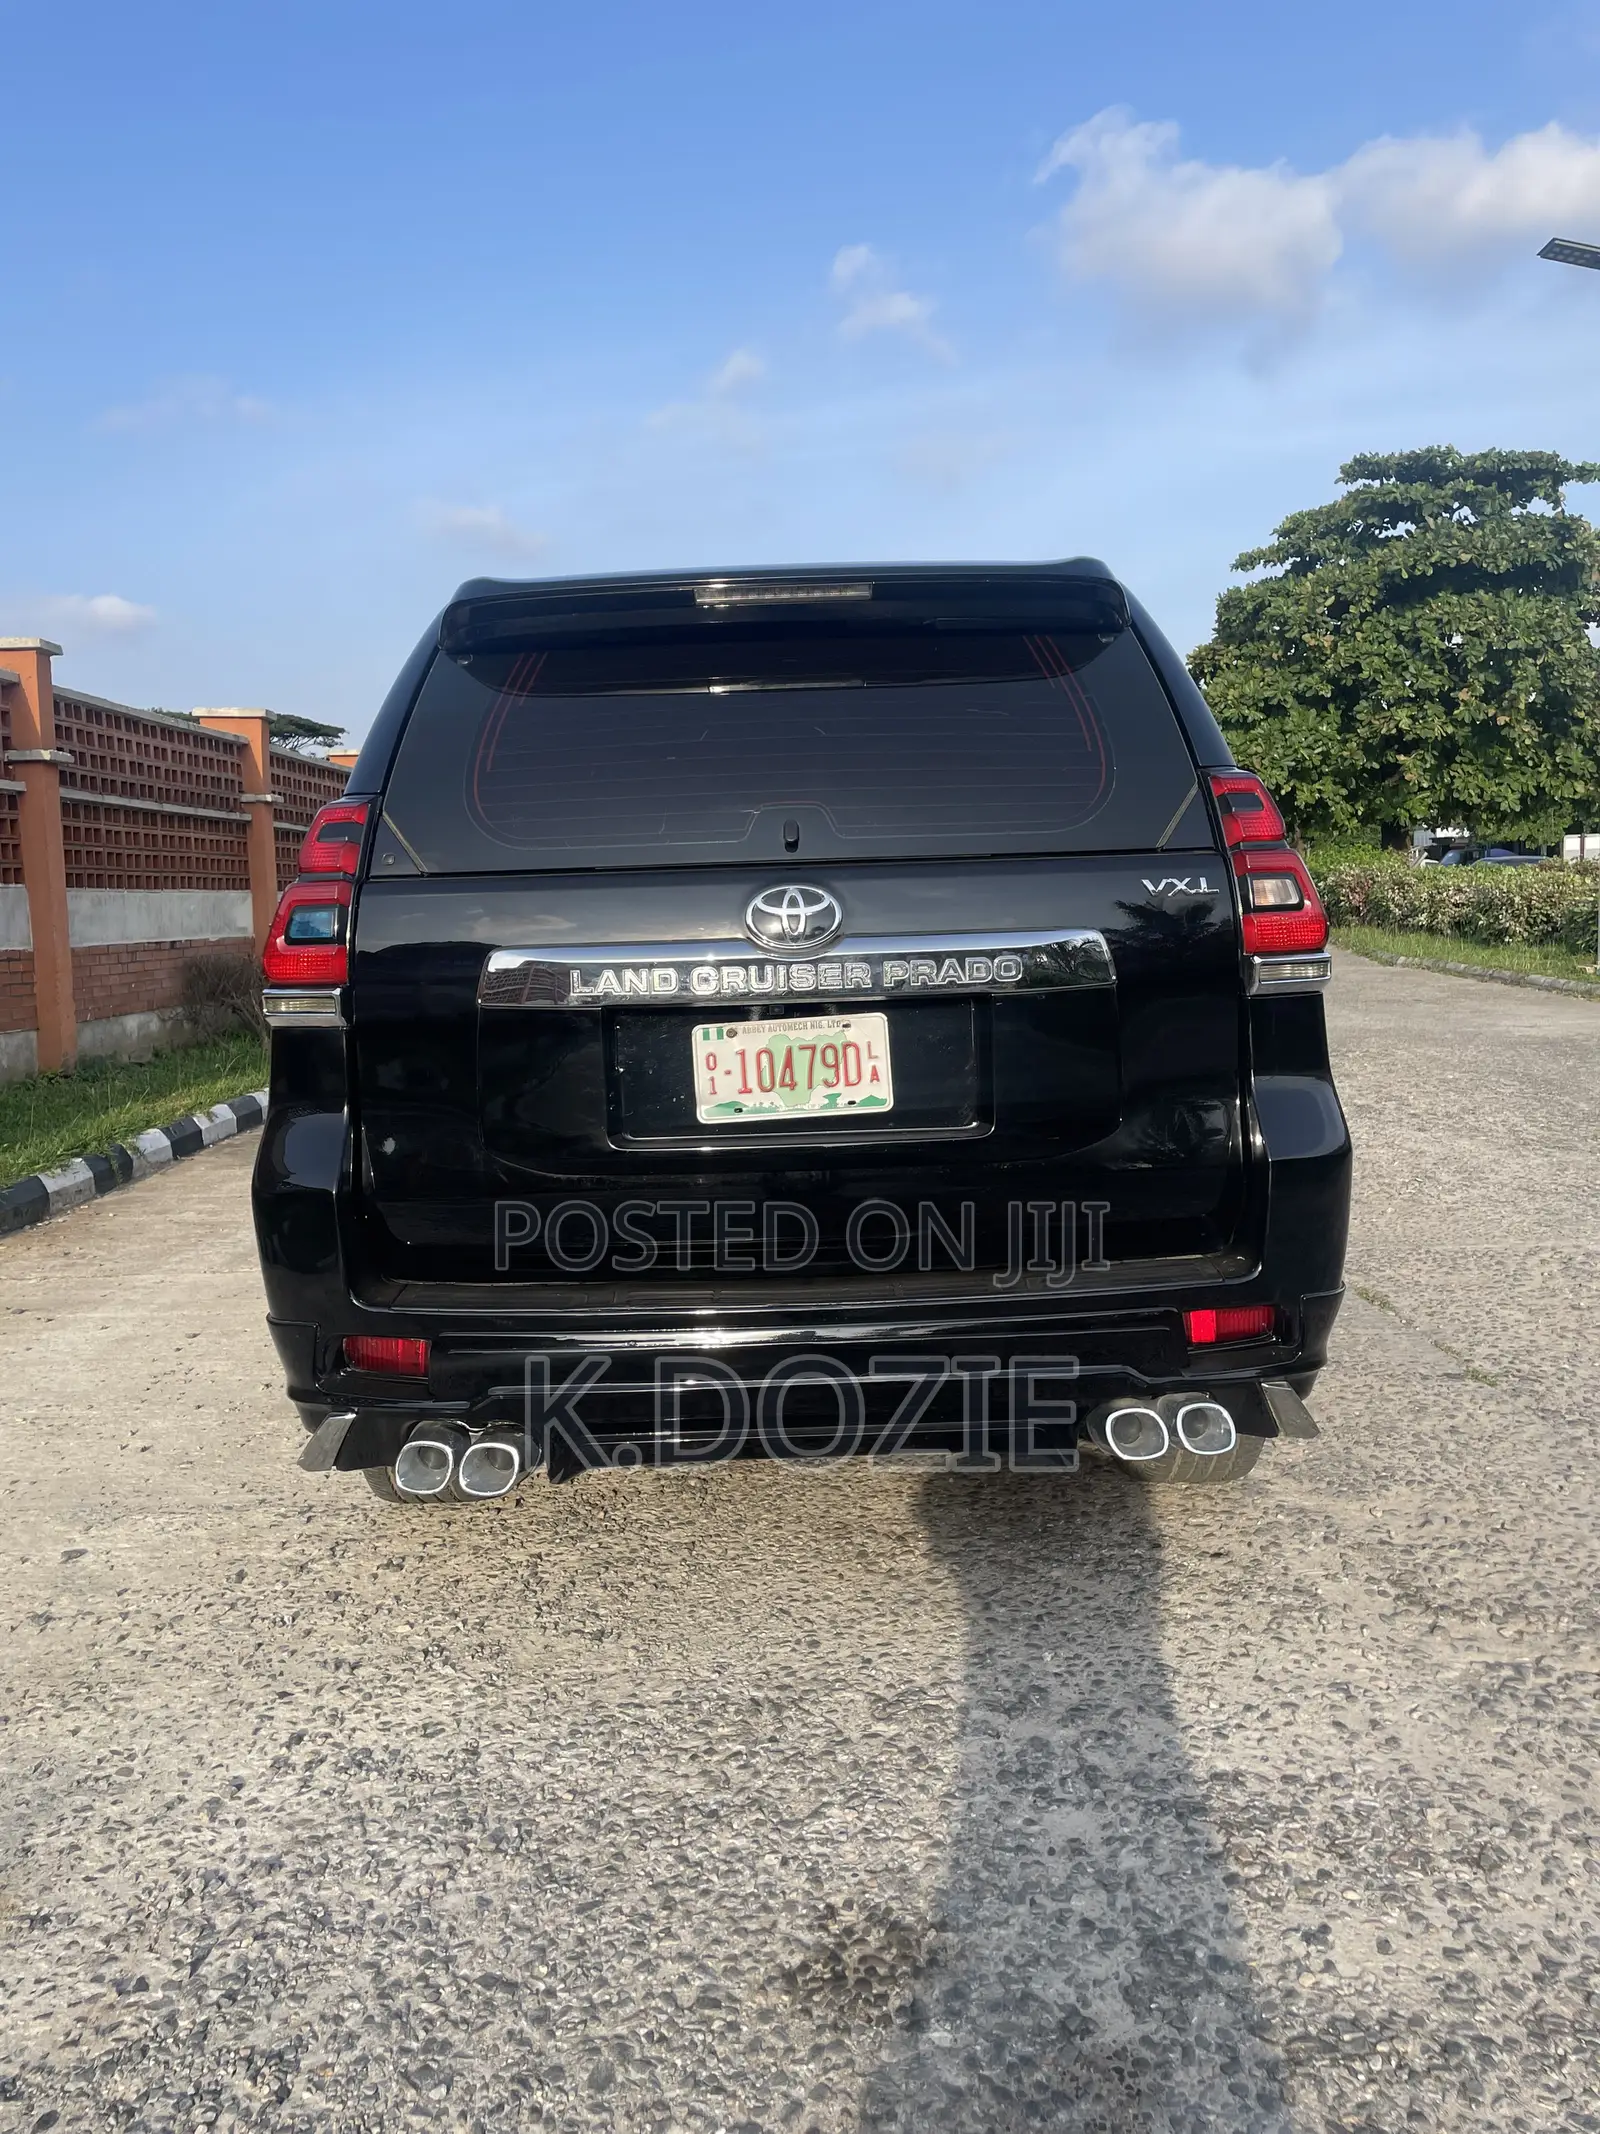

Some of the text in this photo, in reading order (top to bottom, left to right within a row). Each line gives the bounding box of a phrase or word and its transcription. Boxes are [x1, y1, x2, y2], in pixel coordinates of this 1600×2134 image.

[569, 955, 1023, 996] LAND CRUISER PRADO
[768, 1021, 808, 1032] AUTOMECH
